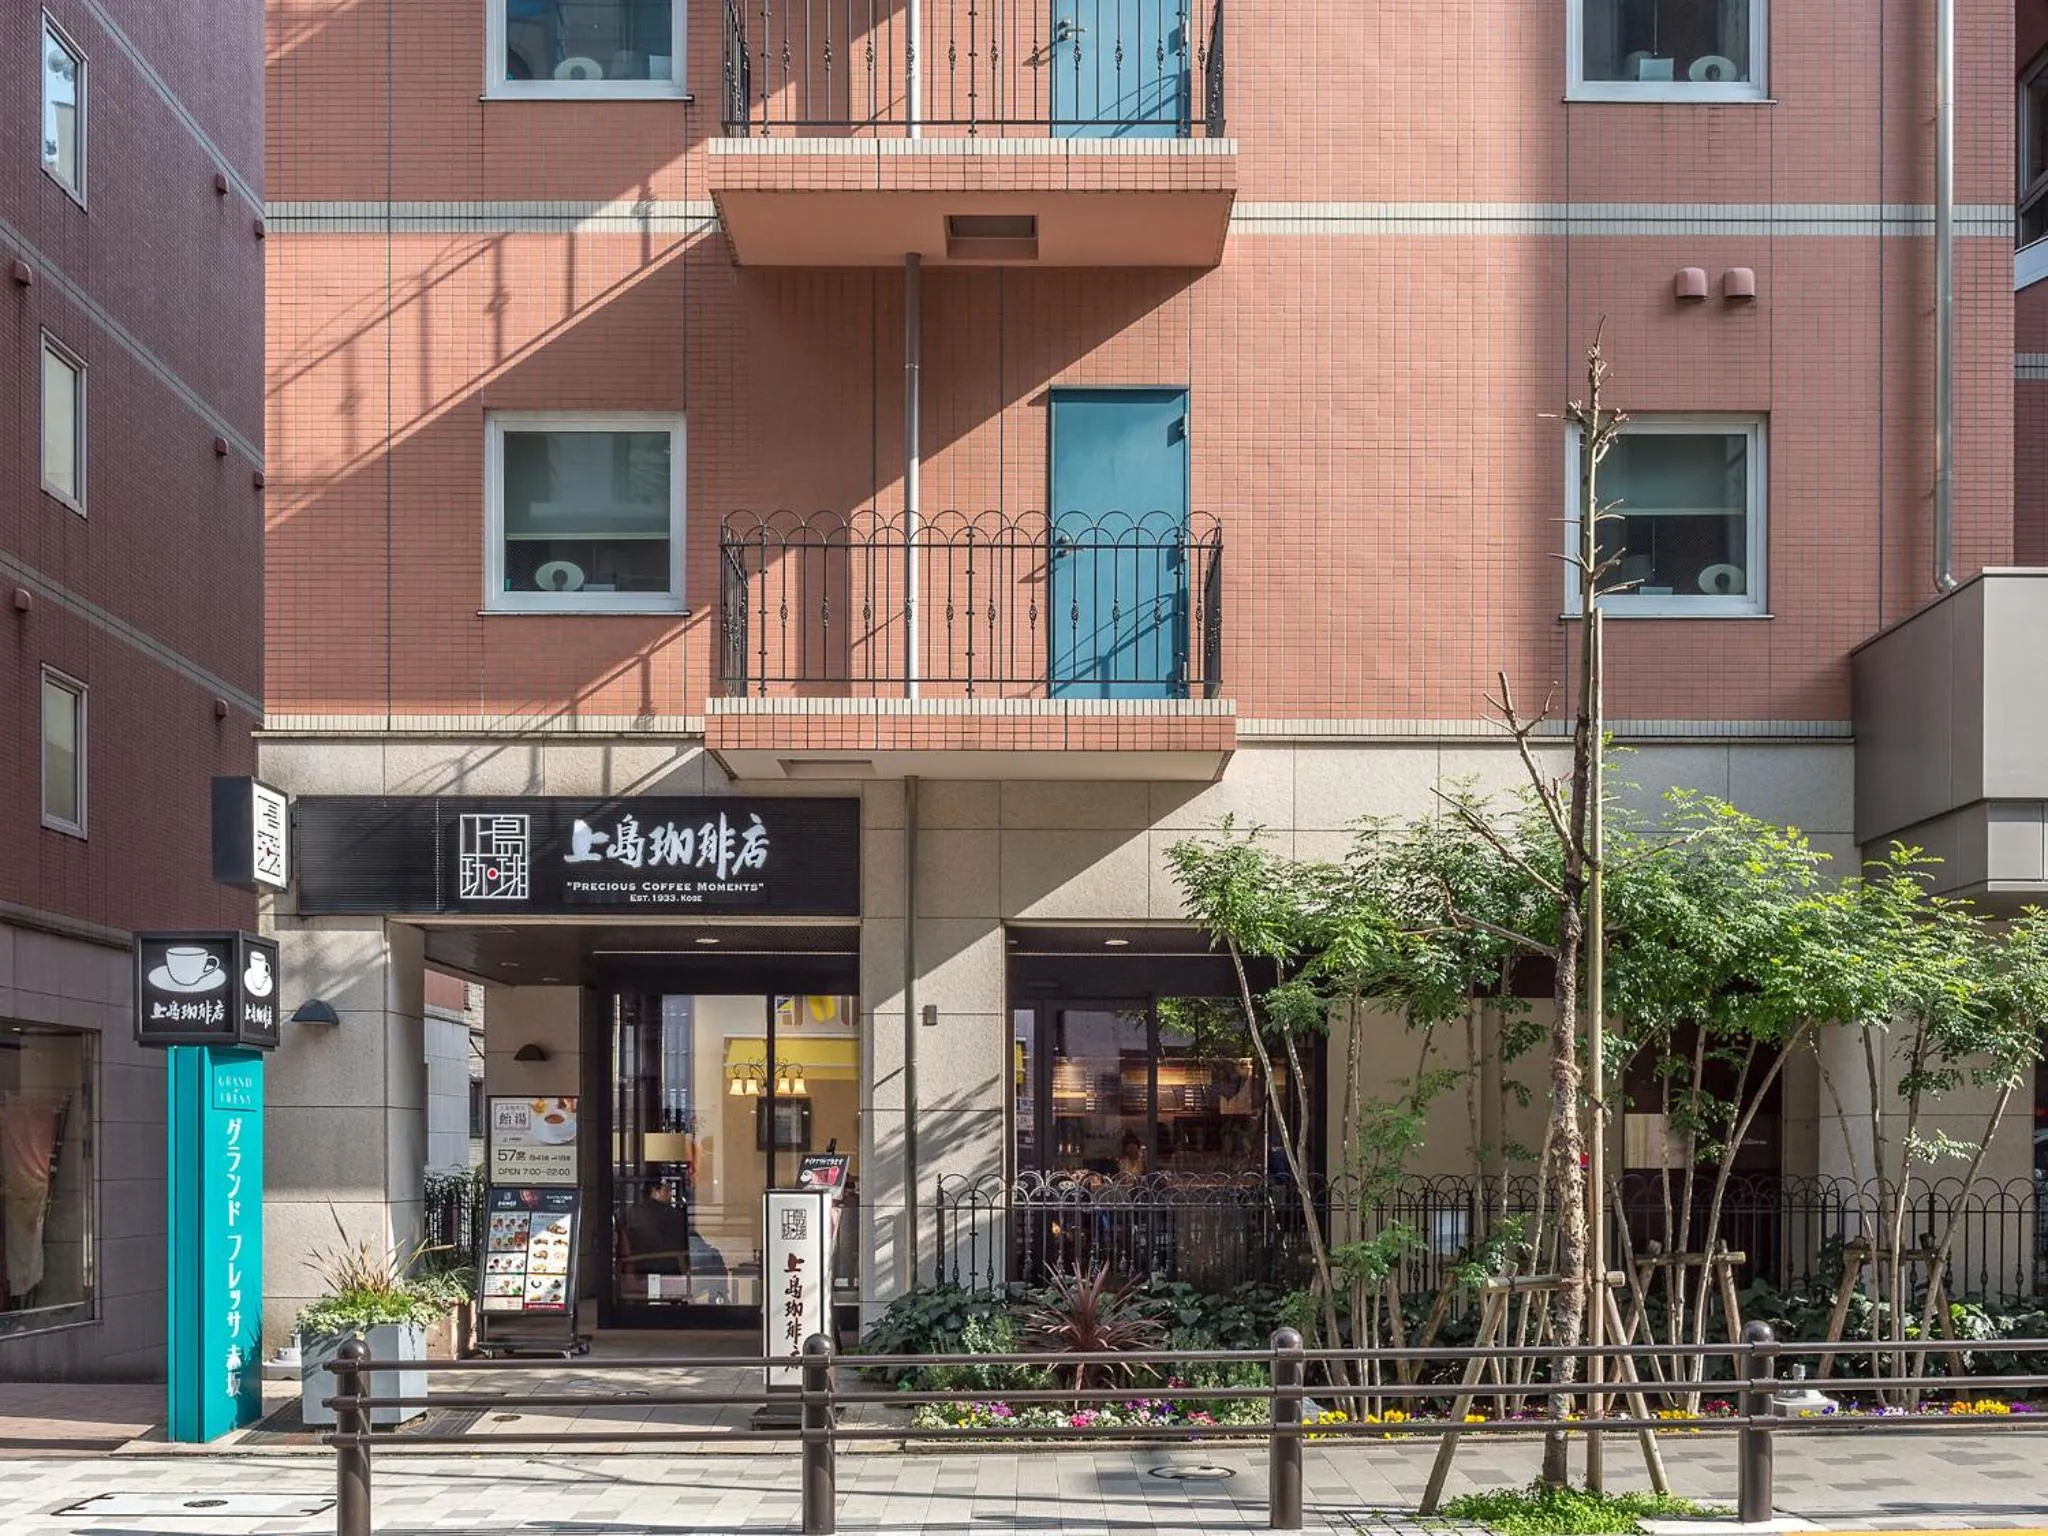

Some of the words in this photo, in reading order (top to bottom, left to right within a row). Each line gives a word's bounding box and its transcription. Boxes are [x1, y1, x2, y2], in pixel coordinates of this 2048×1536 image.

[564, 811, 770, 881] 上島珈琲店
[642, 882, 692, 891] COFFEE
[151, 1000, 225, 1025] 上島珈琲店
[226, 1117, 242, 1227] グランド
[226, 1235, 242, 1338] フレッサ
[226, 1344, 242, 1397] 赤坂
